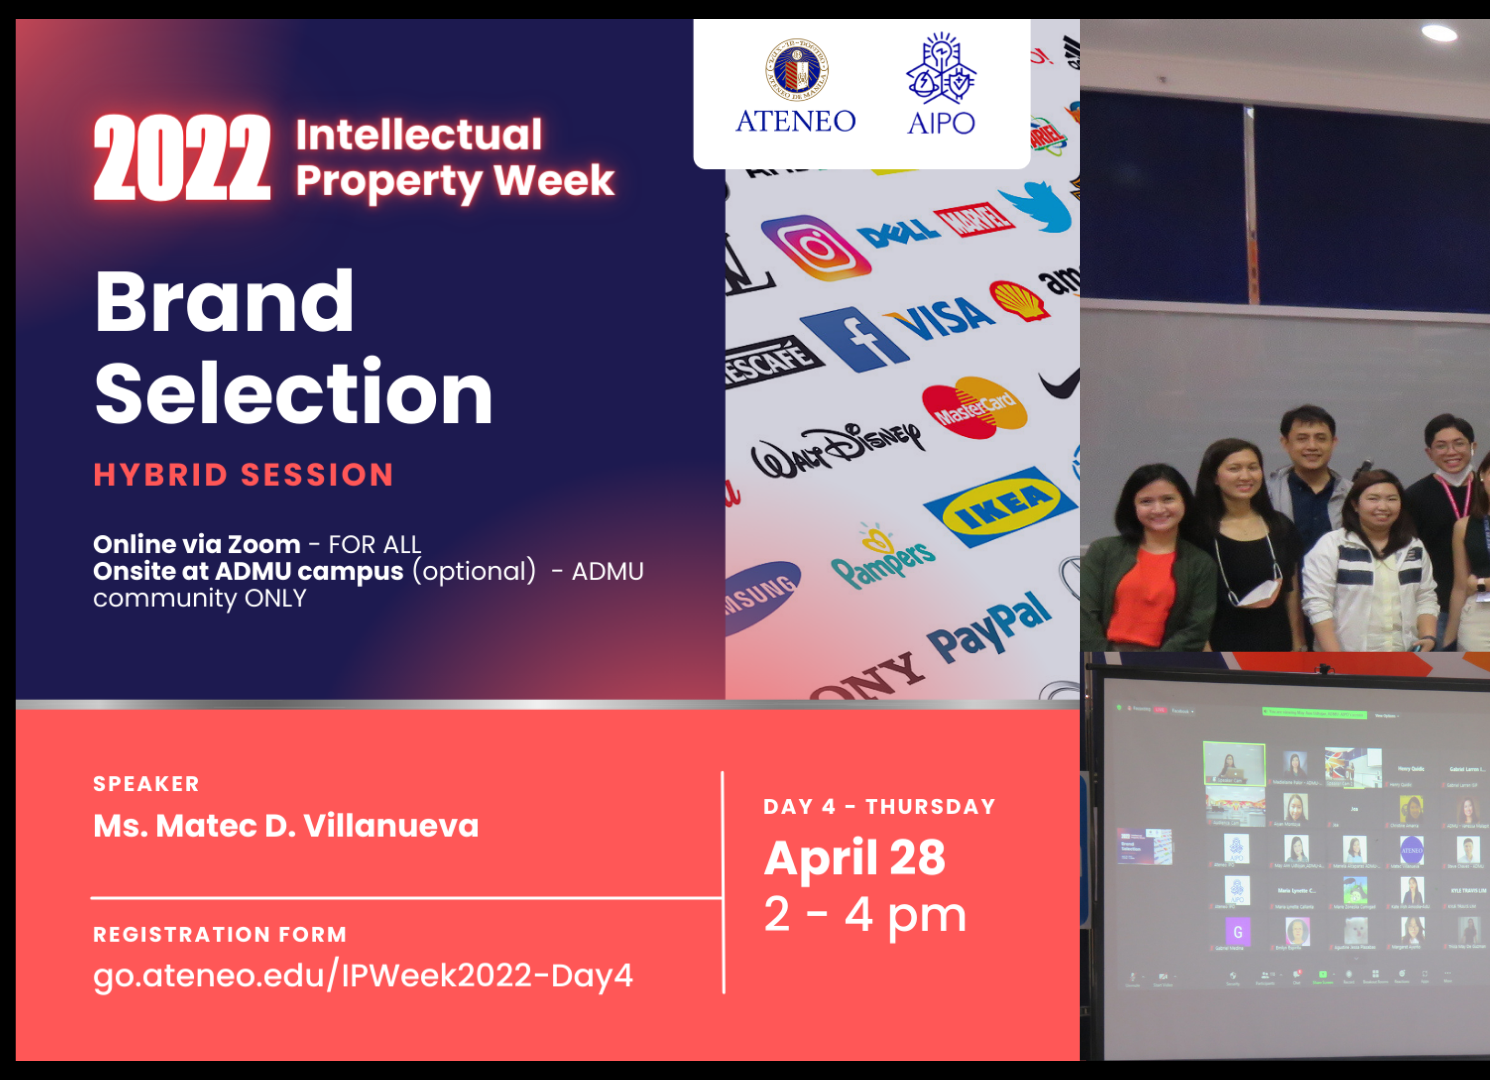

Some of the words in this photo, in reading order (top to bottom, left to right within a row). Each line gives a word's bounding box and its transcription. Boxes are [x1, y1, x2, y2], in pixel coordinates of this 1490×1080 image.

[768, 74, 791, 99] ATENEO
[803, 74, 827, 99] MANILA
[297, 118, 541, 151] Intellectual
[735, 109, 857, 132] ATENEO
[907, 111, 976, 135] AIPO
[1031, 124, 1065, 150] ARIEL
[94, 114, 271, 201] 2022
[297, 164, 484, 207] Property
[494, 164, 615, 196] Week
[856, 218, 942, 249] DELL
[938, 205, 1013, 236] MARVEL
[98, 268, 353, 333] Brand
[881, 297, 997, 341] VISA
[96, 355, 492, 425] Selection
[934, 391, 1017, 426] MasterCard
[94, 463, 227, 486] HYBRID
[241, 463, 392, 487] SESSION
[954, 485, 1054, 530] IKEA
[93, 533, 177, 554] Online
[182, 533, 222, 554] via
[228, 534, 301, 554] Zoom
[329, 534, 375, 554] FOR
[383, 535, 422, 554] ALL
[93, 560, 177, 581] Onsite
[182, 561, 209, 581] at
[214, 561, 291, 581] ADMU
[297, 565, 404, 587] campus
[413, 556, 536, 587] (optional)
[572, 561, 644, 581] ADMU
[830, 543, 937, 591] Pampers
[93, 587, 238, 614] community
[245, 588, 307, 608] ONLY
[926, 590, 1053, 665] PayPal
[93, 775, 199, 792] SPEAKER
[763, 798, 813, 815] DAY
[821, 798, 836, 815] 4
[865, 798, 996, 815] THURSDAY
[94, 813, 148, 838] Ms.
[156, 813, 257, 838] Matec
[265, 813, 296, 838] D.
[303, 811, 479, 838] Villanueva
[763, 836, 877, 888] April
[890, 839, 946, 876] 28
[93, 926, 270, 943] REGISTRATION
[279, 926, 346, 943] FORM
[765, 895, 790, 931] 2
[845, 895, 873, 932] 4
[889, 904, 966, 944] pm
[1233, 926, 1243, 939] G
[93, 956, 634, 996] go.ateneo.edu/IPWeek2022-Day4
